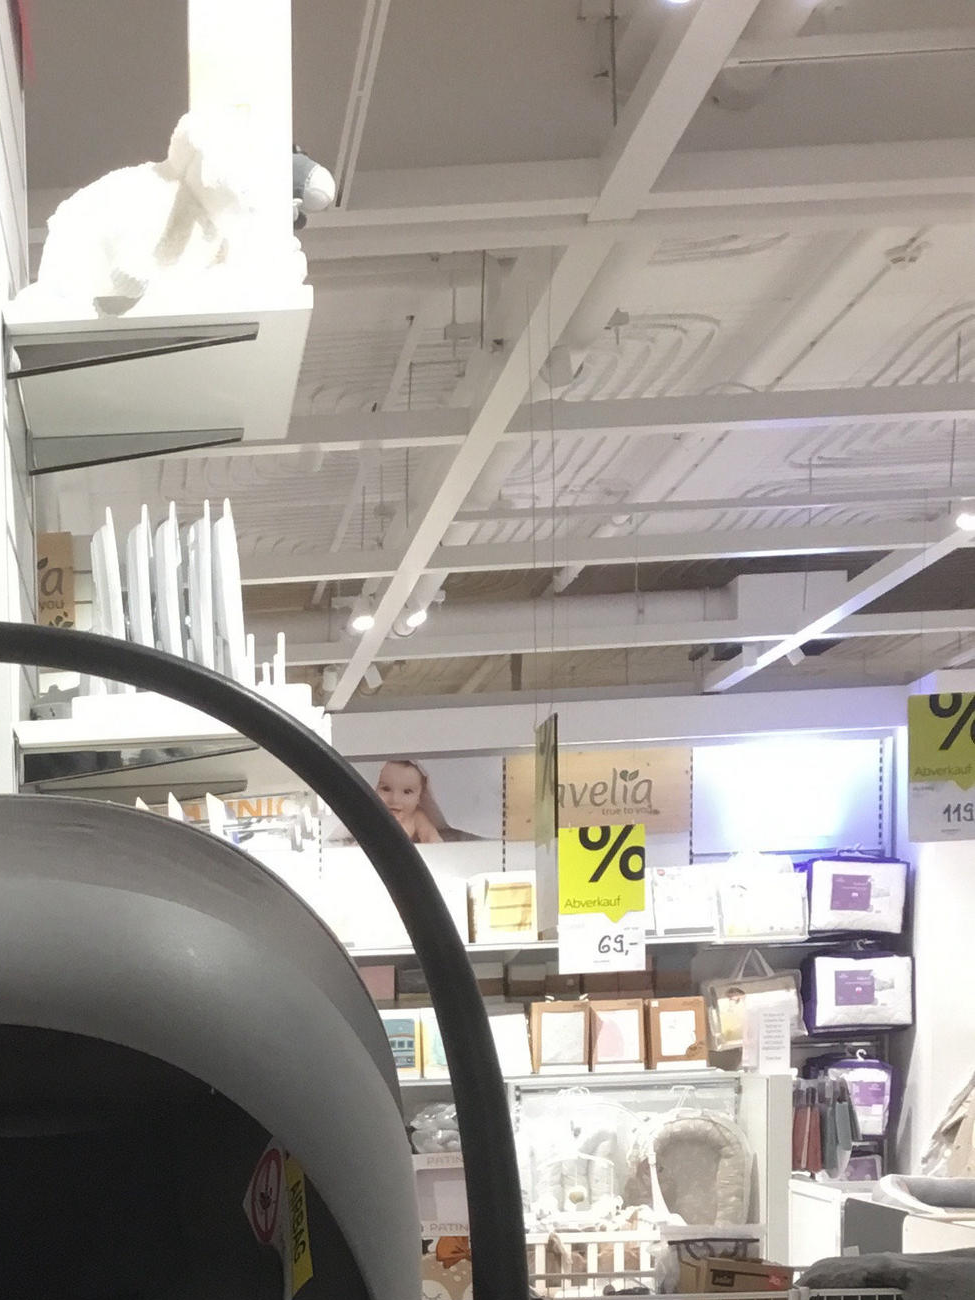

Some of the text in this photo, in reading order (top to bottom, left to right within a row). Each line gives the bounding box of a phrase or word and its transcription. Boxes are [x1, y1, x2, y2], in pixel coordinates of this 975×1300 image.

[913, 764, 973, 777] Abverkauf
[564, 895, 622, 909] Abverkauf
[598, 934, 639, 955] 69,-
[290, 1179, 306, 1264] AIRBAG
